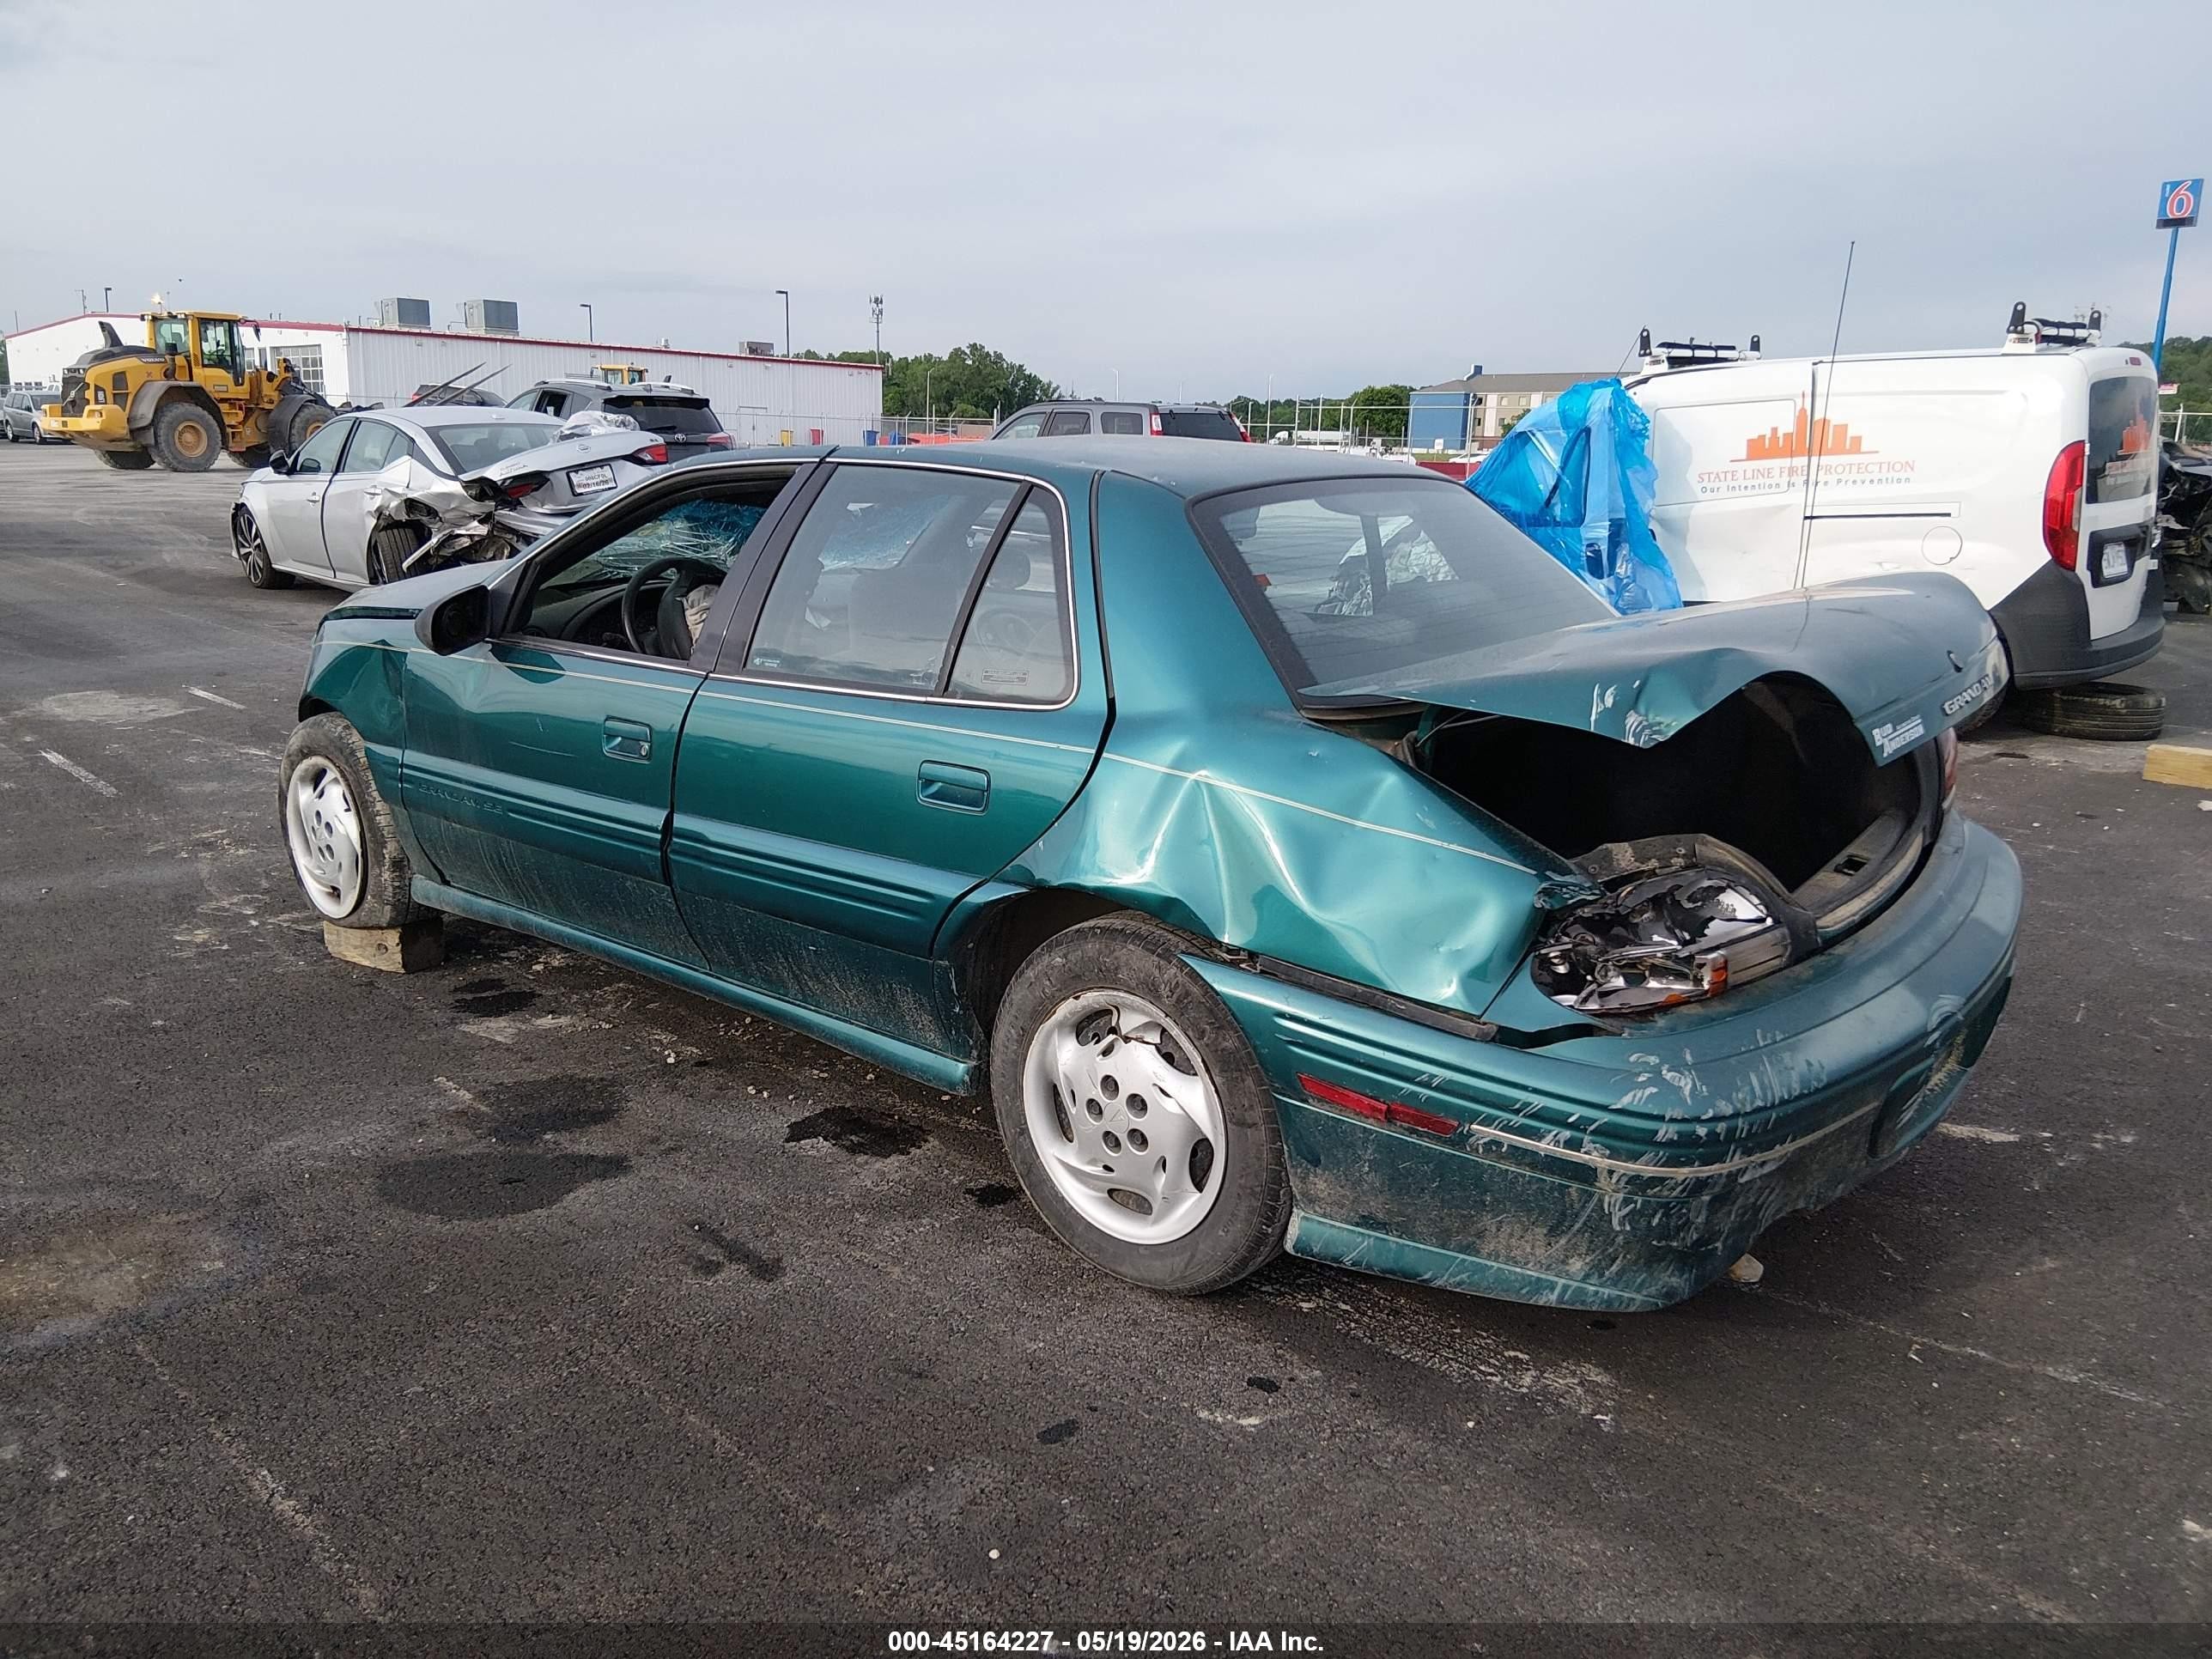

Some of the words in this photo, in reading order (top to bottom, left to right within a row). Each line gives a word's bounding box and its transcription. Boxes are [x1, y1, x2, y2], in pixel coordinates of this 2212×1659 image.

[2166, 180, 2193, 218] 6
[1697, 470, 1739, 483] STATE
[1743, 467, 1775, 481] LINE
[1779, 465, 1808, 478] FIRE
[1818, 460, 1916, 477] PROTECTION
[1700, 485, 1721, 494] Our
[1727, 483, 1780, 492] Intention
[1802, 479, 1829, 488] Fire
[1836, 477, 1911, 486] Prevention
